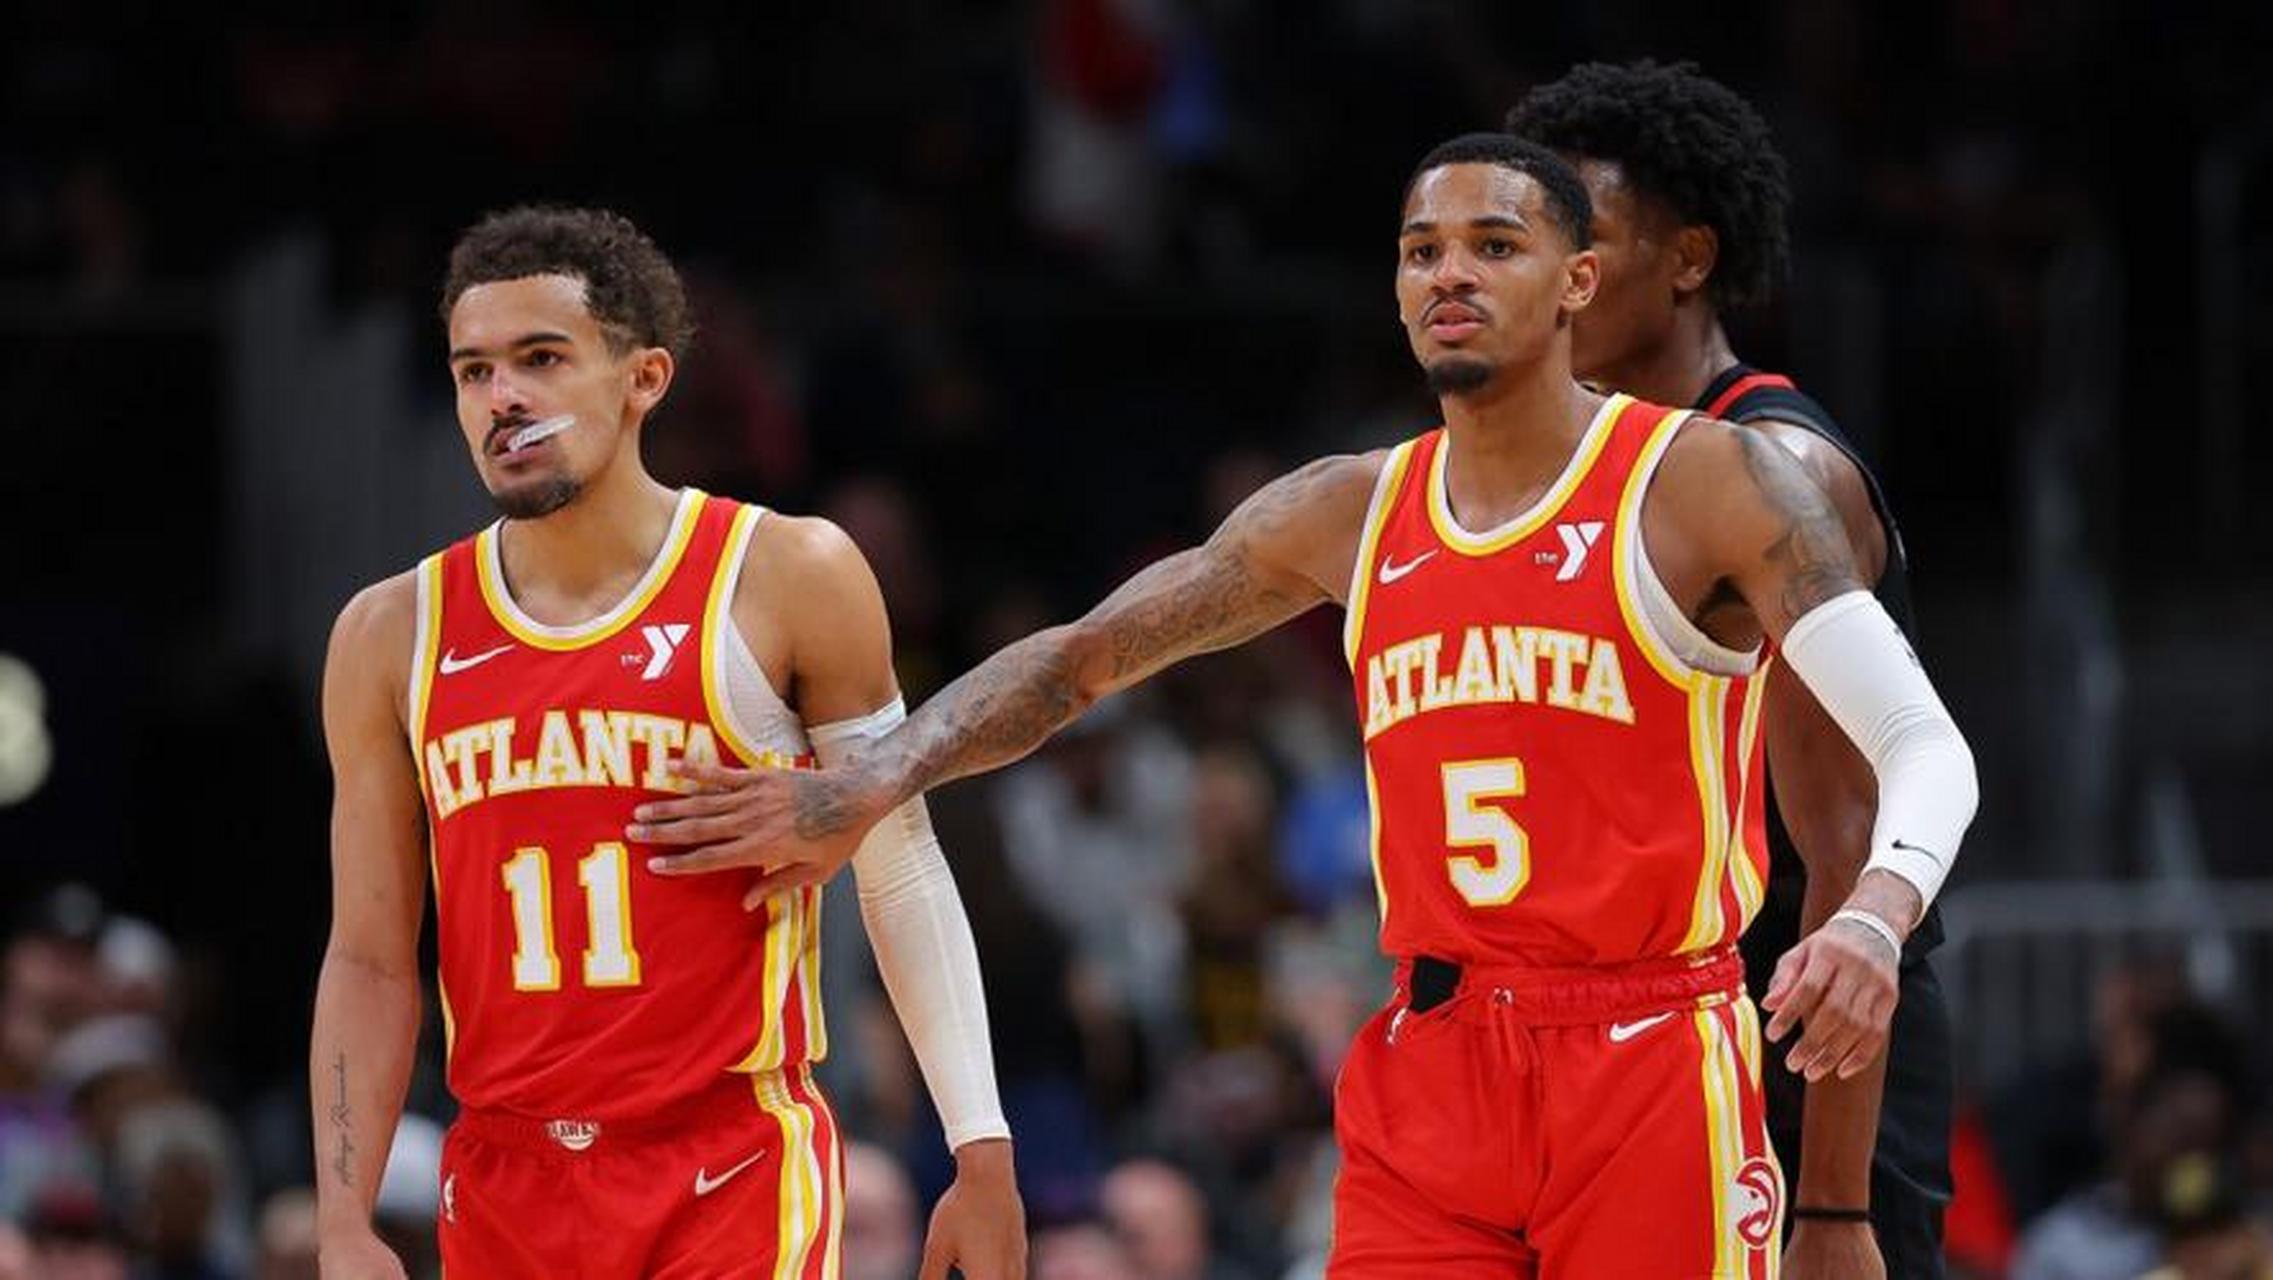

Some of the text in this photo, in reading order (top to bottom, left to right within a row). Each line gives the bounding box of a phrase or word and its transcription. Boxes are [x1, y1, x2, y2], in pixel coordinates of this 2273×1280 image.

[1365, 625, 1636, 742] ATLANTA
[1441, 757, 1531, 907] 5
[502, 842, 641, 991] 11
